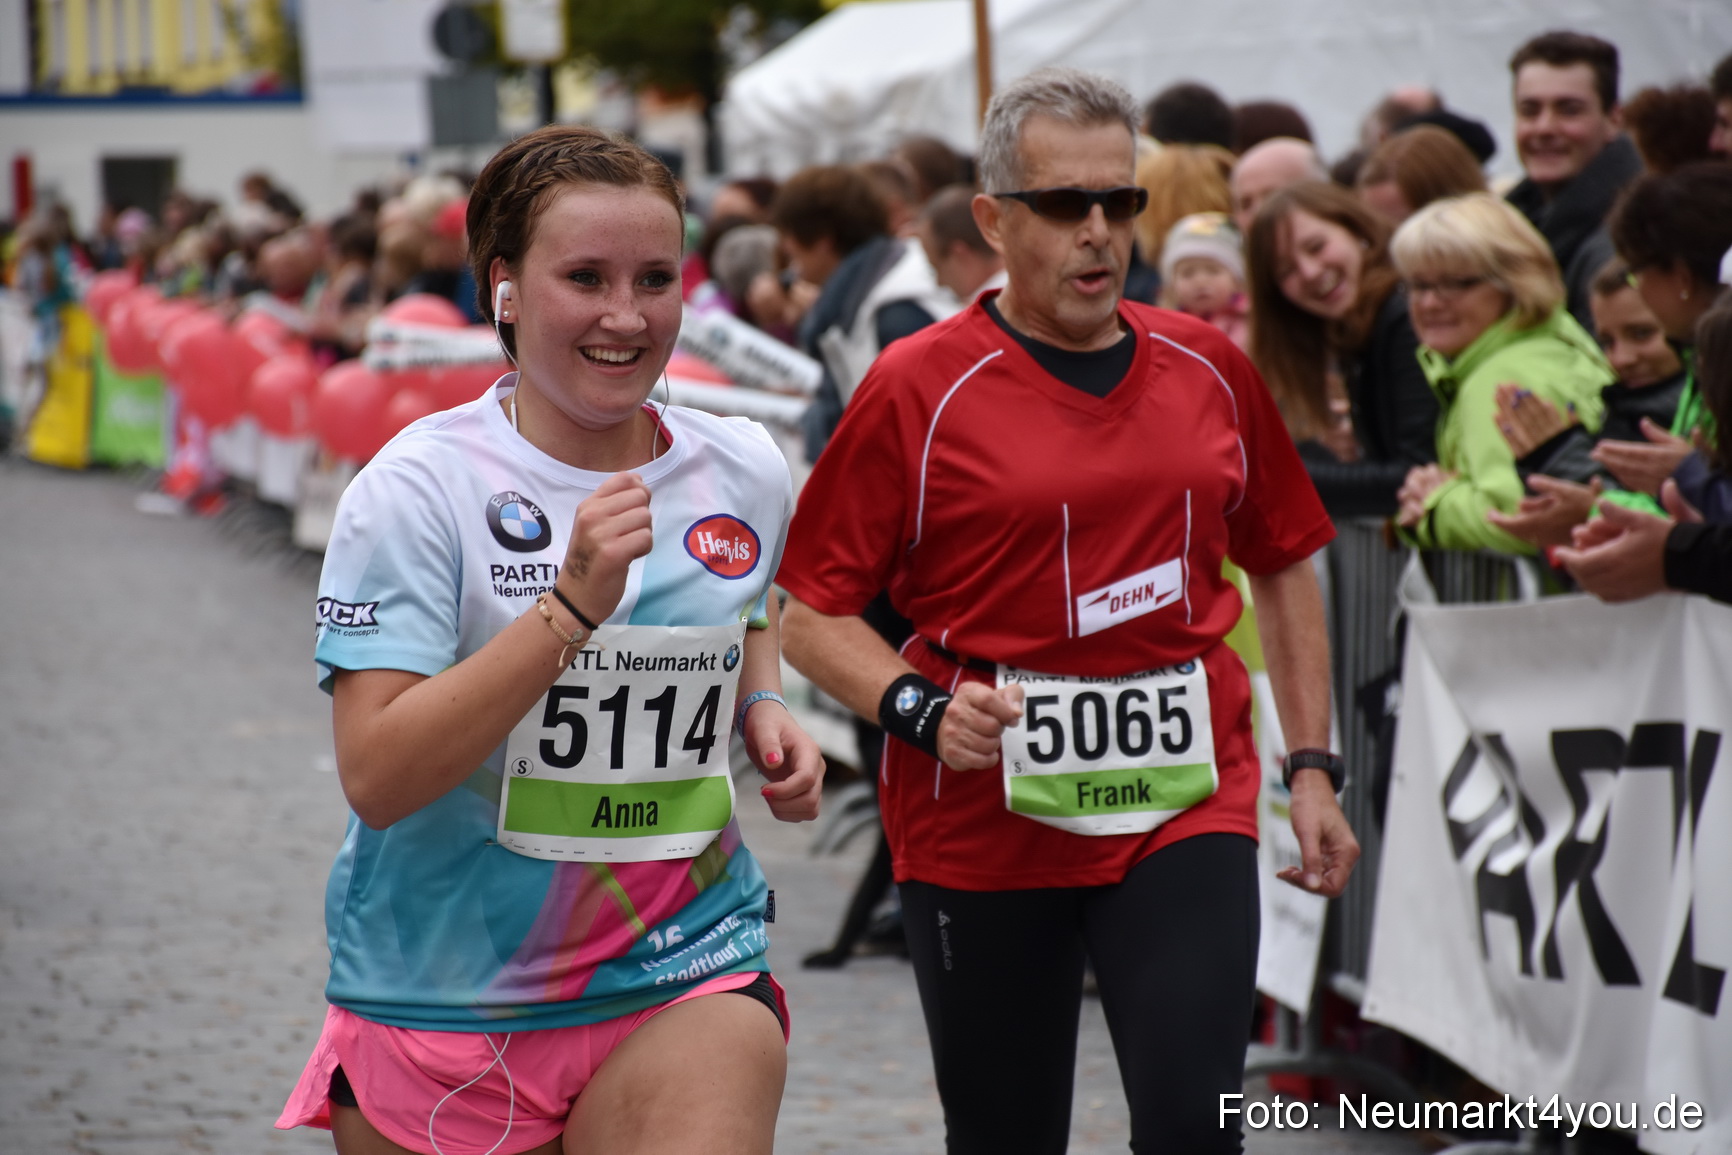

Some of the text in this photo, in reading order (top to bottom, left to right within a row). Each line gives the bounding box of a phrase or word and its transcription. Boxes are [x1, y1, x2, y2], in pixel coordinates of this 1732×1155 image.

[491, 492, 543, 519] BMW
[696, 531, 750, 564] Hervis
[493, 583, 556, 598] Neumar
[1109, 580, 1155, 615] DEHN
[343, 628, 380, 637] concepts
[616, 650, 717, 672] Neumarkt
[539, 684, 722, 770] 5114
[1026, 685, 1193, 765] 5065
[517, 760, 528, 776] S
[1014, 762, 1023, 774] S
[1077, 778, 1153, 809] Frank
[591, 796, 659, 829] Anna
